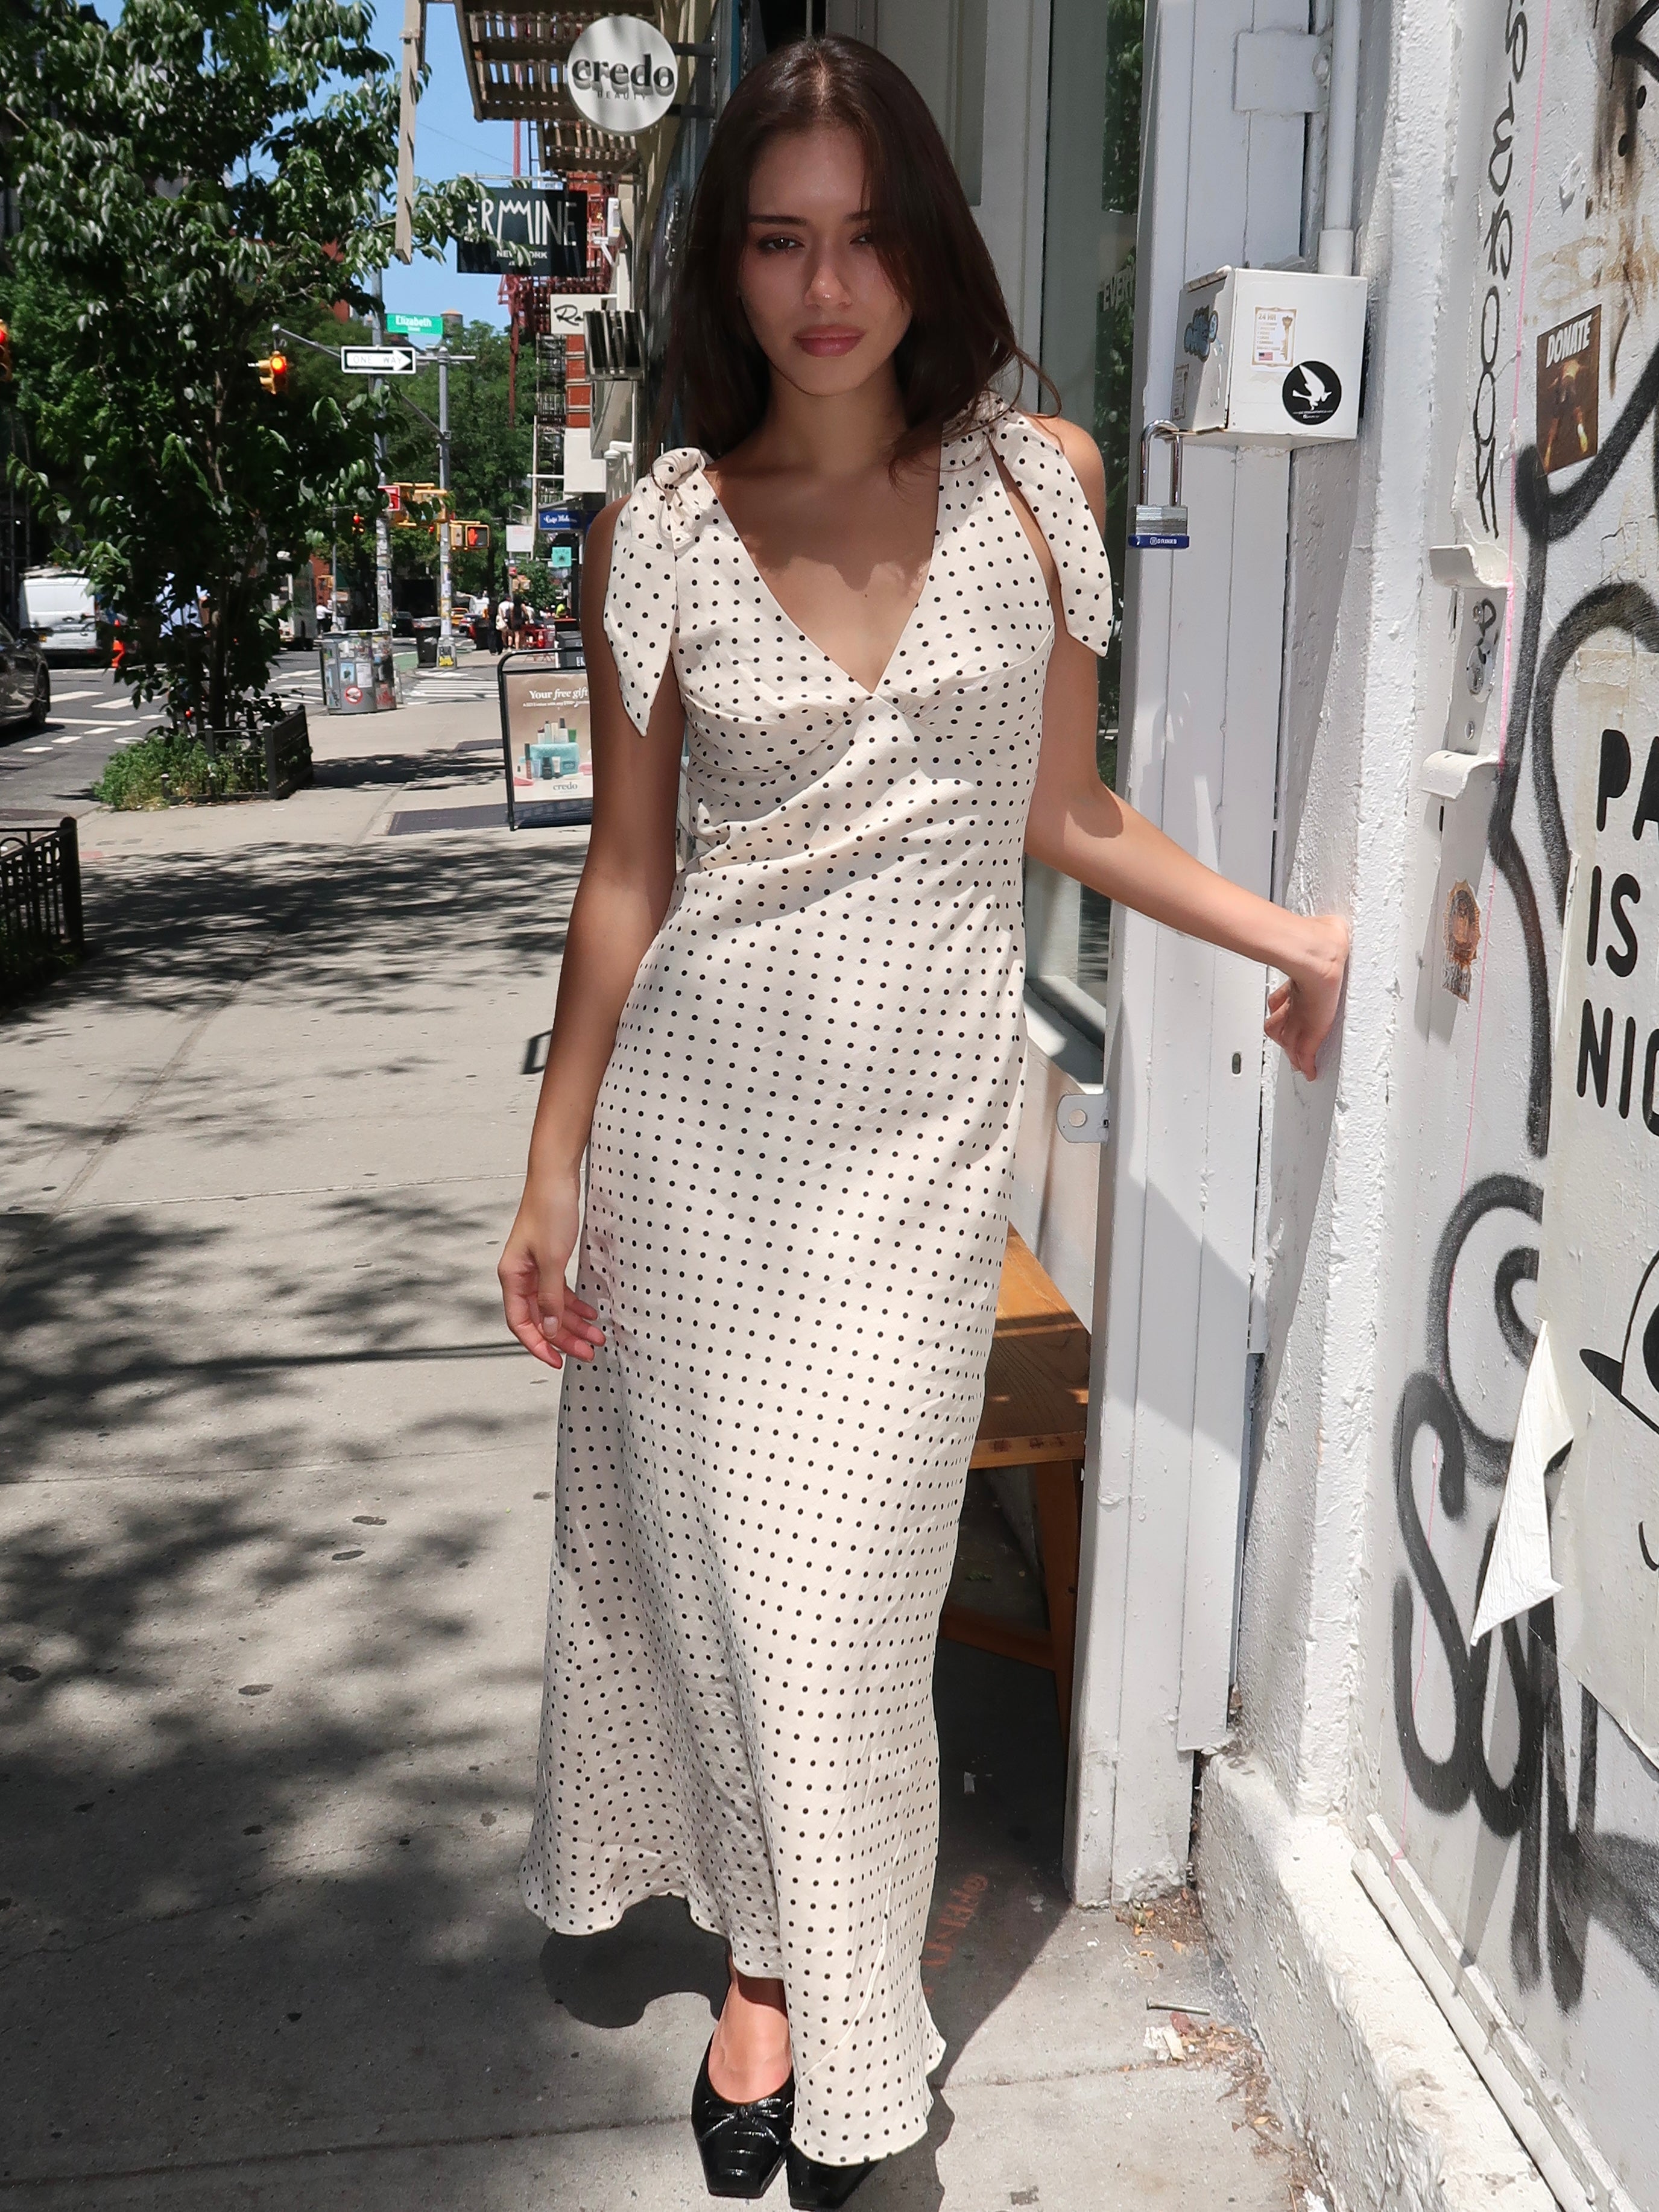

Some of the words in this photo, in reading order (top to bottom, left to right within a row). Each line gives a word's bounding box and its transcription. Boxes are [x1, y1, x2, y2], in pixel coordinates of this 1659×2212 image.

[572, 53, 674, 88] credo
[395, 315, 432, 327] Elizabeth
[1546, 314, 1592, 369] DONATE
[353, 355, 372, 364] ONE
[382, 356, 403, 365] WAY
[529, 690, 553, 700] Your
[553, 688, 572, 701] free
[572, 686, 588, 700] gift
[552, 782, 578, 791] credo
[1587, 865, 1641, 978] IS
